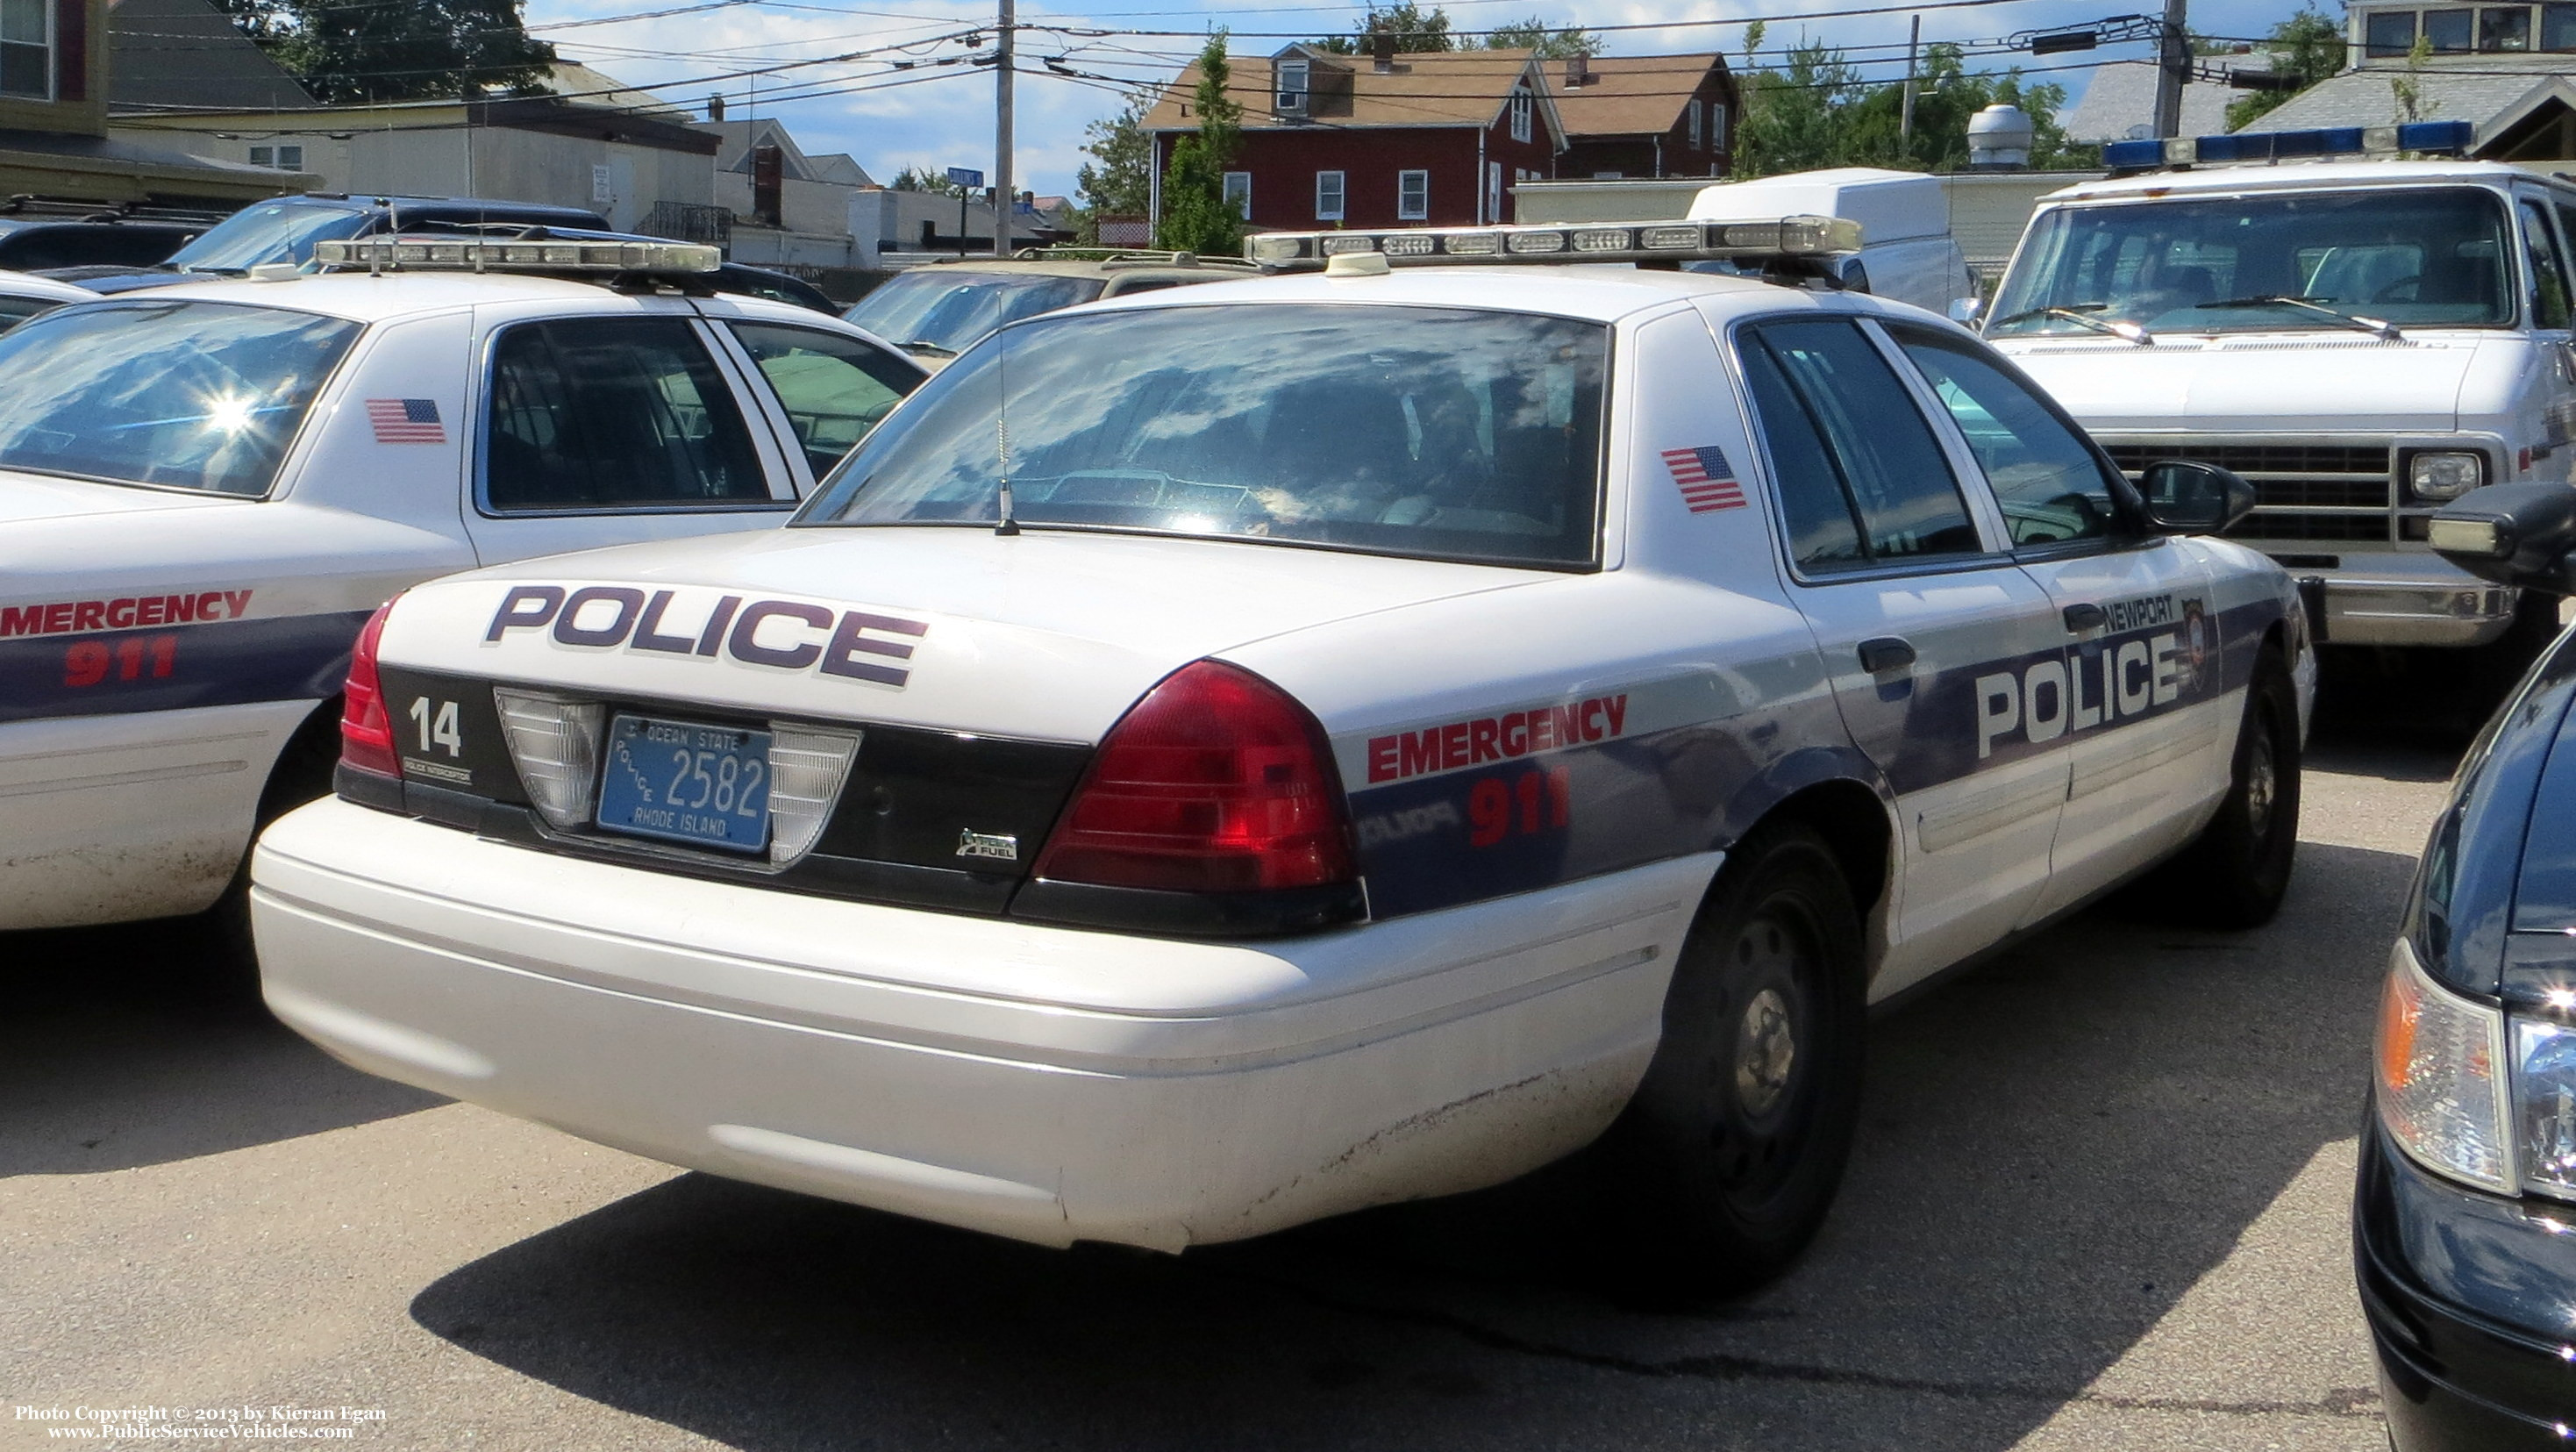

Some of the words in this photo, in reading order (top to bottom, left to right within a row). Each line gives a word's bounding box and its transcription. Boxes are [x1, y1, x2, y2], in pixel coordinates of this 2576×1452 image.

[0, 590, 253, 636] MERGENCY
[480, 585, 930, 690] POLICE
[2103, 596, 2173, 633] NEWPORT
[65, 634, 179, 688] 911
[410, 696, 461, 758] 14
[1975, 633, 2178, 760] POLICE
[647, 726, 689, 746] OCEAN
[698, 731, 739, 751] STATE
[1368, 694, 1627, 784] EMERGENCY
[616, 740, 653, 803] POLICE
[667, 747, 764, 819] 2582
[634, 806, 674, 830] RHODE
[680, 814, 726, 837] ISLAND
[1469, 764, 1570, 848] 911
[981, 847, 1014, 858] FUEL
